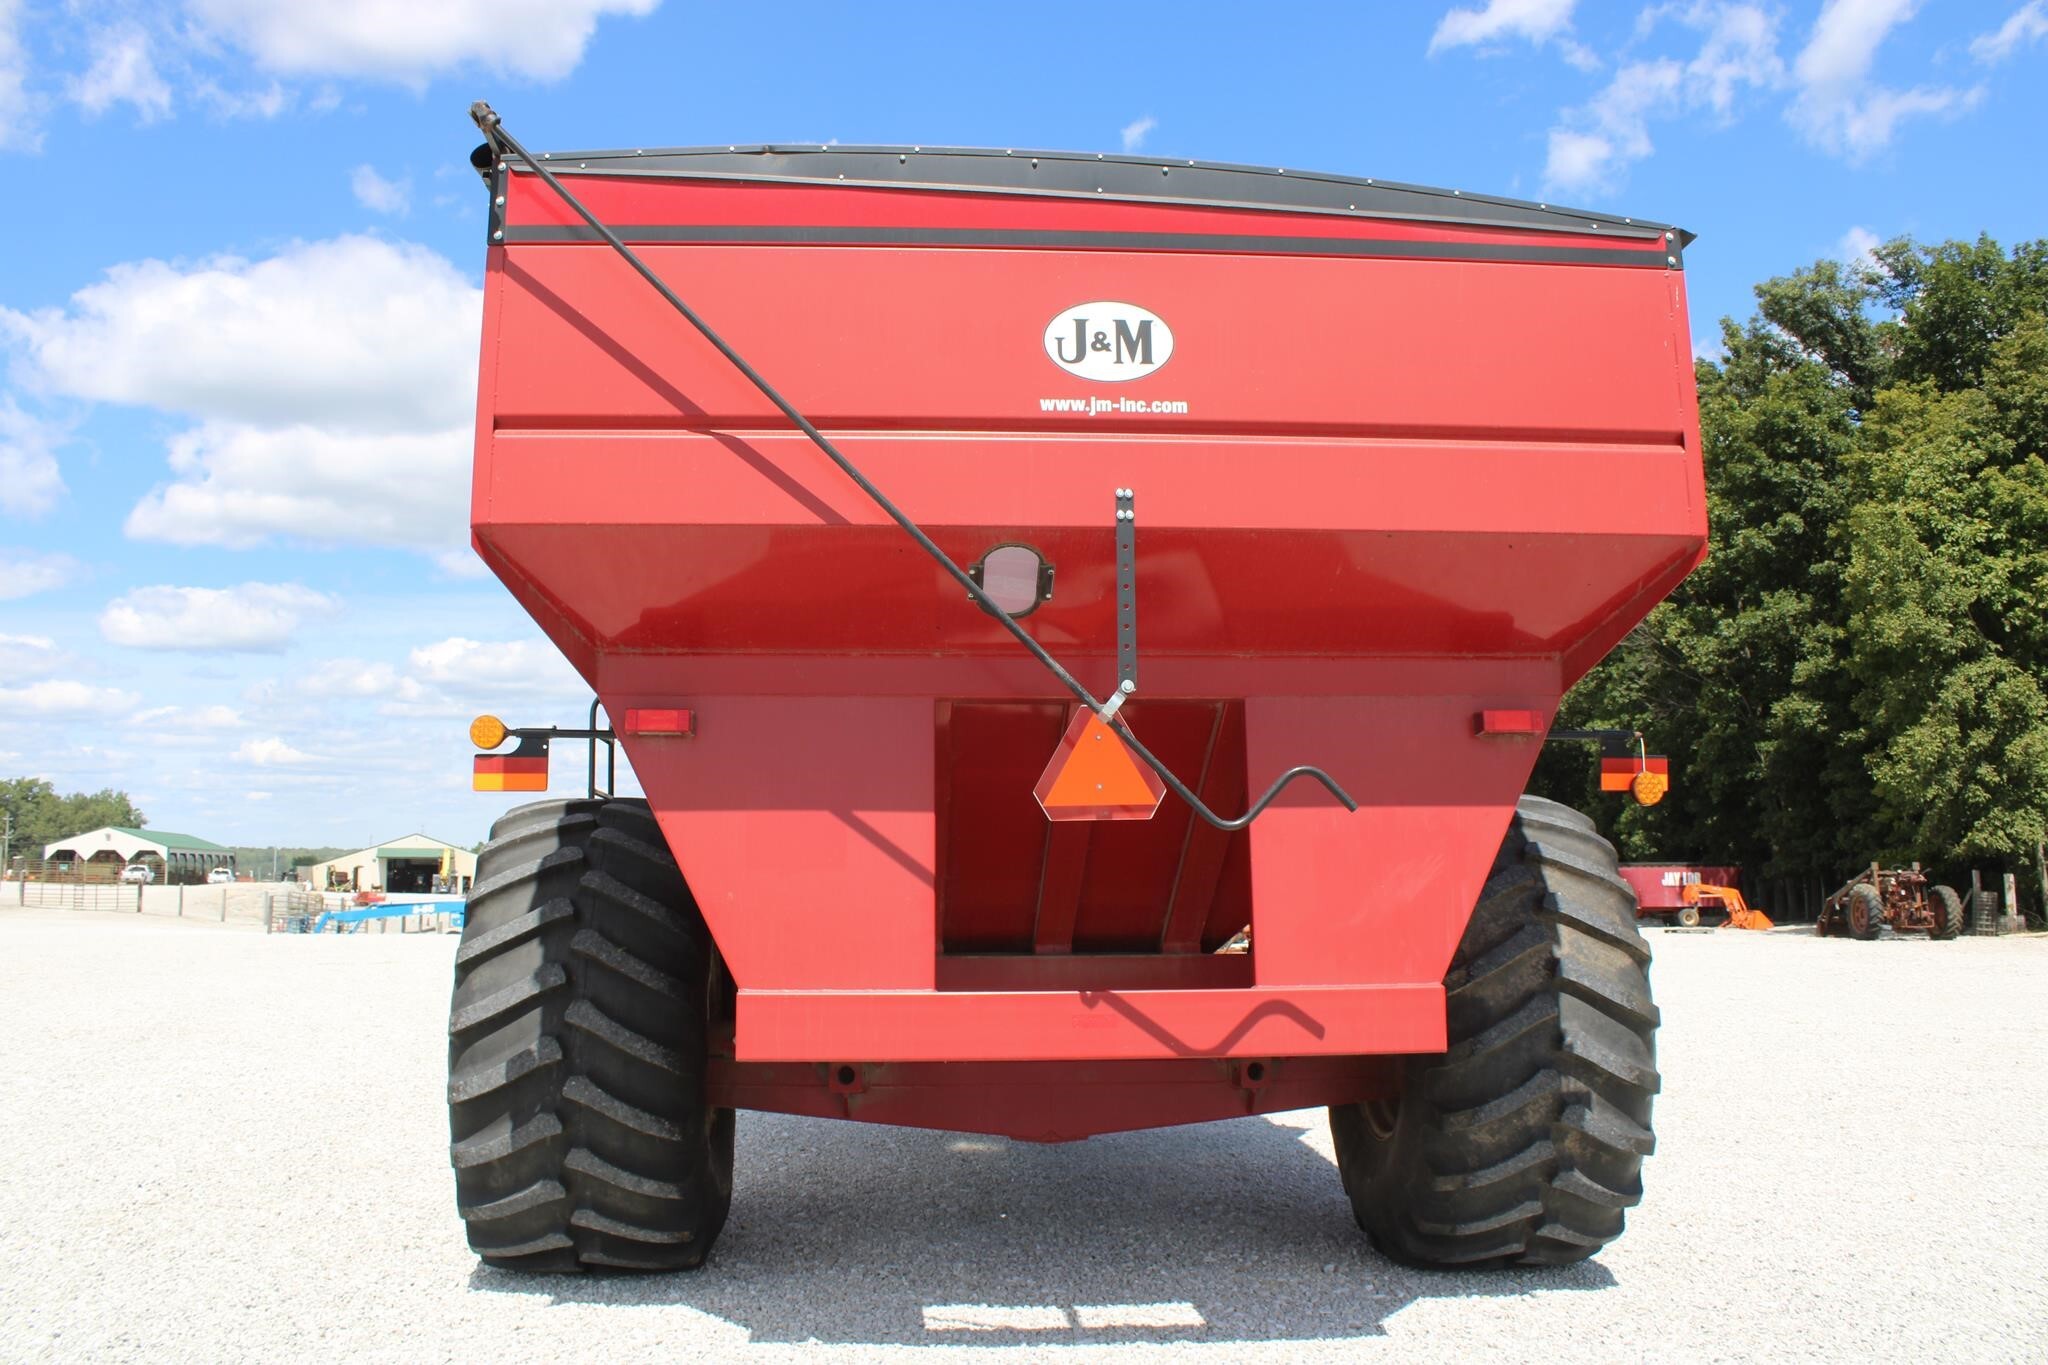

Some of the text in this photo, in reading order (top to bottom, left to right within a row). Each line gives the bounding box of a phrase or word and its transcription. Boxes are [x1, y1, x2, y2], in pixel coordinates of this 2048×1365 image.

[1055, 318, 1154, 364] J&M
[1040, 397, 1188, 415] www.jm-inc.com
[1661, 871, 1681, 886] JAY
